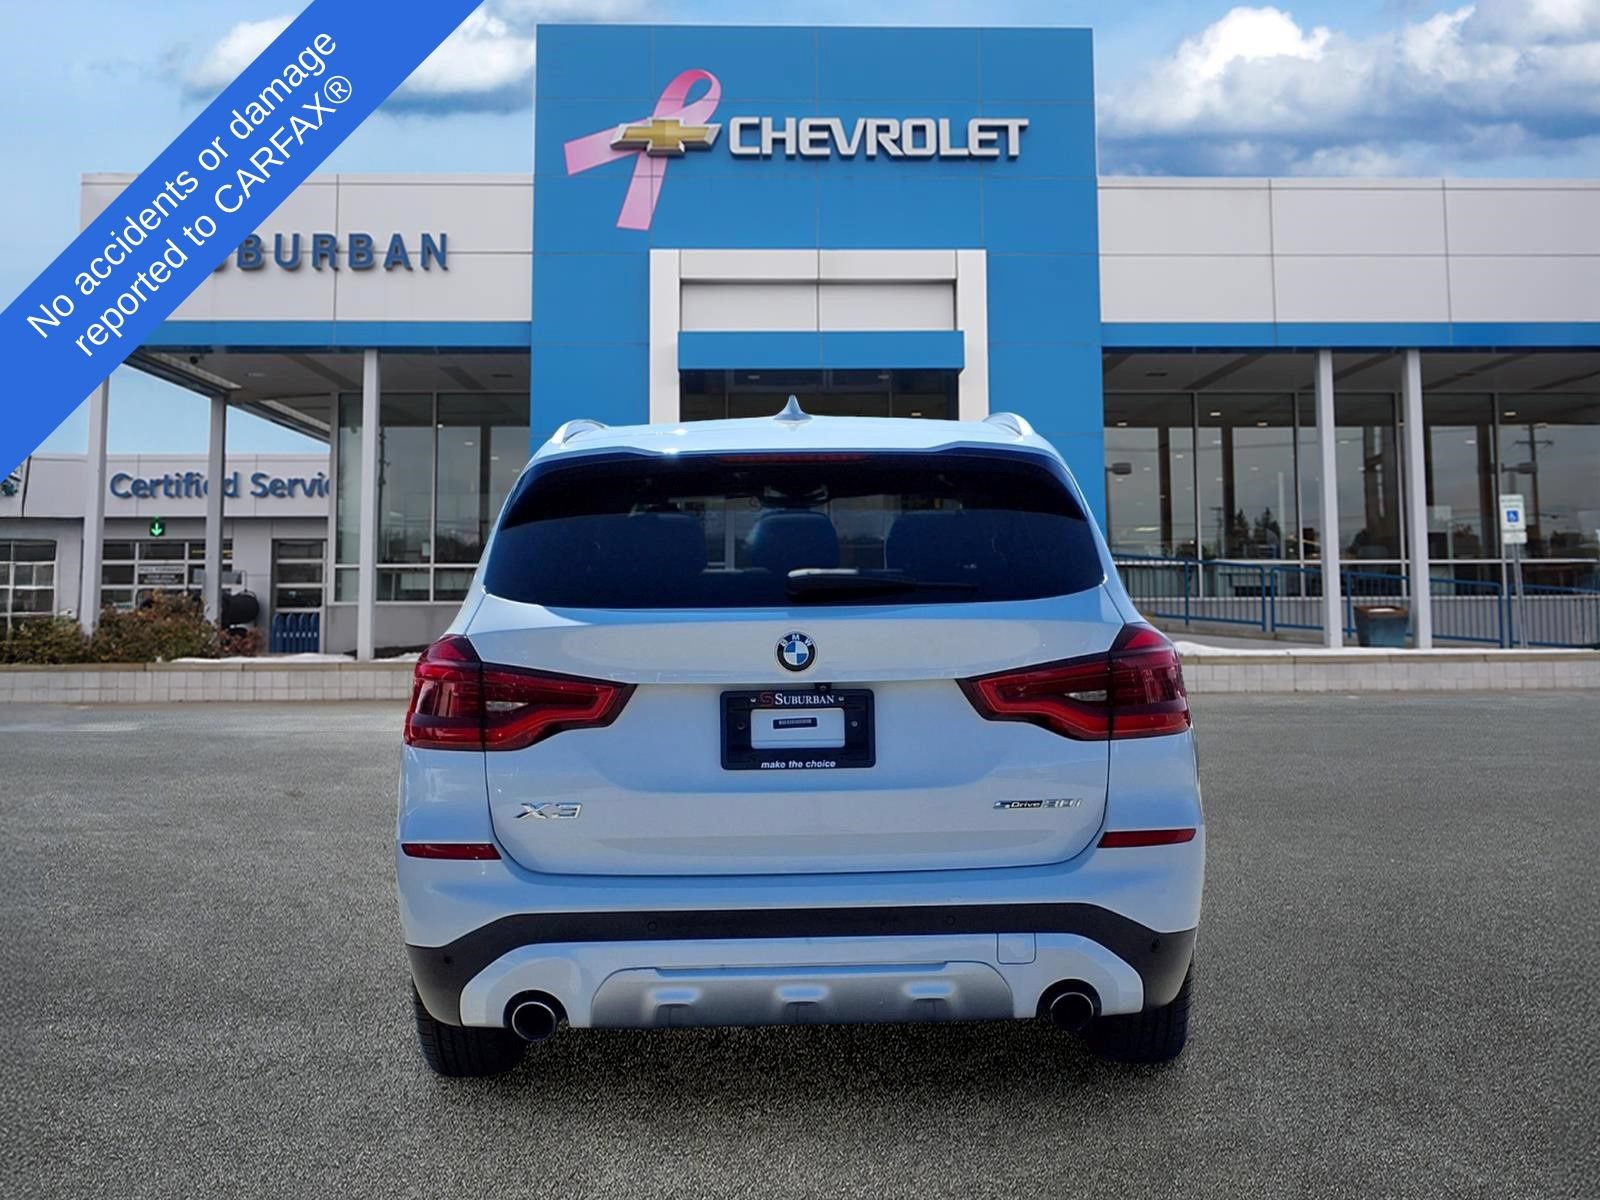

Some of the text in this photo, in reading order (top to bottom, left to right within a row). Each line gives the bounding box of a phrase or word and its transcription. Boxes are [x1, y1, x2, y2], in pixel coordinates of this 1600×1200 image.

[728, 116, 1029, 159] CHEVROLET
[215, 232, 449, 272] BURBAN
[109, 472, 330, 498] Certifid Servi
[780, 633, 813, 647] BMW
[775, 692, 835, 705] SUBURBAN
[761, 760, 836, 769] make the choice
[514, 802, 583, 820] X3
